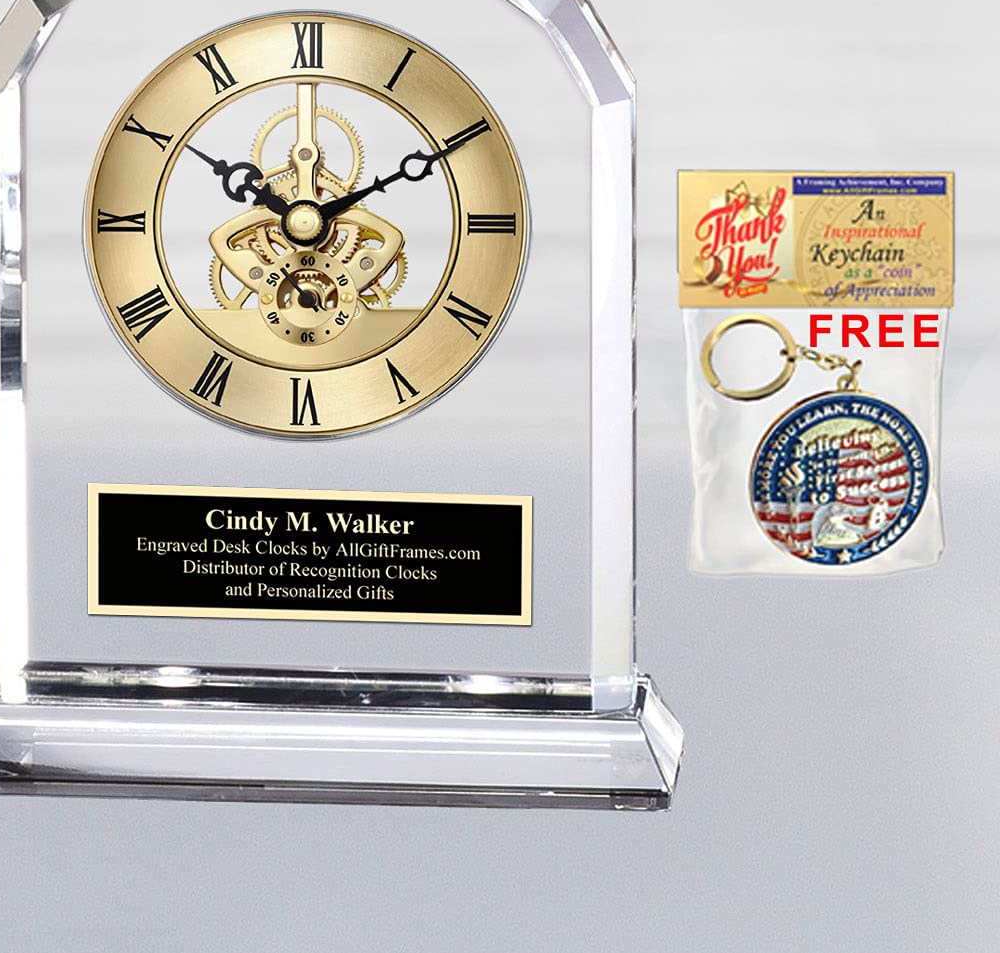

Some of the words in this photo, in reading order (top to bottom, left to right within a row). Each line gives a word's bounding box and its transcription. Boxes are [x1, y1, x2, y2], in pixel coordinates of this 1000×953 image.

[291, 22, 324, 69] XII
[193, 43, 239, 95] XI
[852, 199, 885, 224] An
[467, 212, 517, 235] III
[695, 188, 786, 260] Thank
[824, 222, 926, 243] Inspirational
[300, 255, 316, 266] 60
[809, 240, 904, 268] Keychain
[266, 272, 281, 287] 50
[336, 273, 349, 287] 10
[844, 267, 859, 278] as
[863, 268, 873, 278] a
[823, 281, 843, 302] of
[841, 283, 936, 301] Appreciation
[205, 509, 278, 536] Cindy
[285, 511, 317, 532] M.
[326, 512, 415, 534] Walker
[137, 537, 208, 555] Engraved
[213, 539, 250, 554] Desk
[255, 540, 308, 555] Clocks
[312, 542, 331, 559] by
[336, 543, 481, 560] AllGiftFrames.com
[183, 559, 265, 575] Distributor
[269, 562, 287, 576] of
[290, 562, 381, 581] Recognition
[385, 565, 438, 580] Clocks
[225, 583, 252, 597] and
[257, 583, 351, 599] Personalized
[356, 585, 395, 600] Gifts
